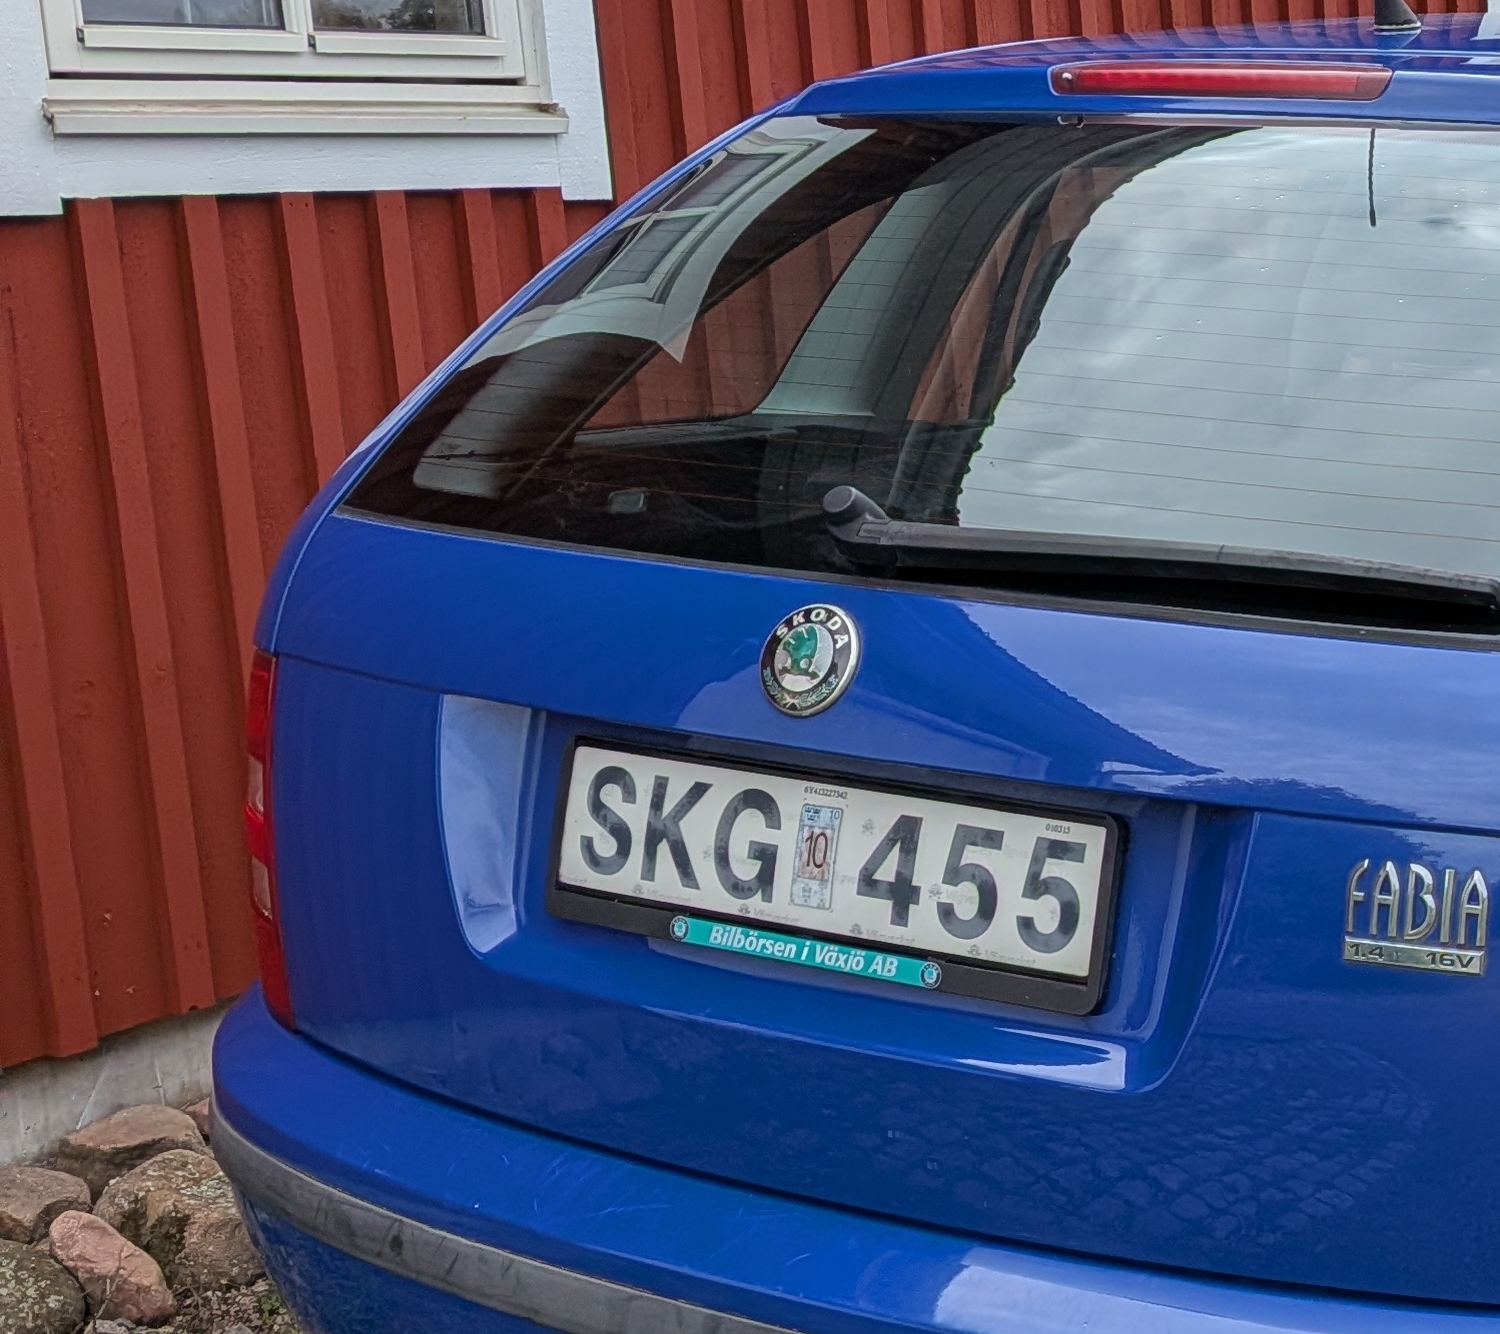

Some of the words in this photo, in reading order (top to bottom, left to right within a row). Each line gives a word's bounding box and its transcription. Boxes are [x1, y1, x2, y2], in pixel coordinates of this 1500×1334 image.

[829, 809, 840, 820] 10
[1045, 823, 1071, 834] 010315
[579, 765, 783, 904] SKG
[855, 814, 1087, 955] 455
[804, 830, 829, 869] 10
[1346, 858, 1489, 948] FABIA
[708, 924, 797, 959] Bilbörsen
[800, 941, 811, 961] i
[814, 944, 866, 973] Växjö
[867, 956, 899, 978] AB
[1349, 943, 1385, 960] 1.4
[1426, 952, 1476, 969] 16V
